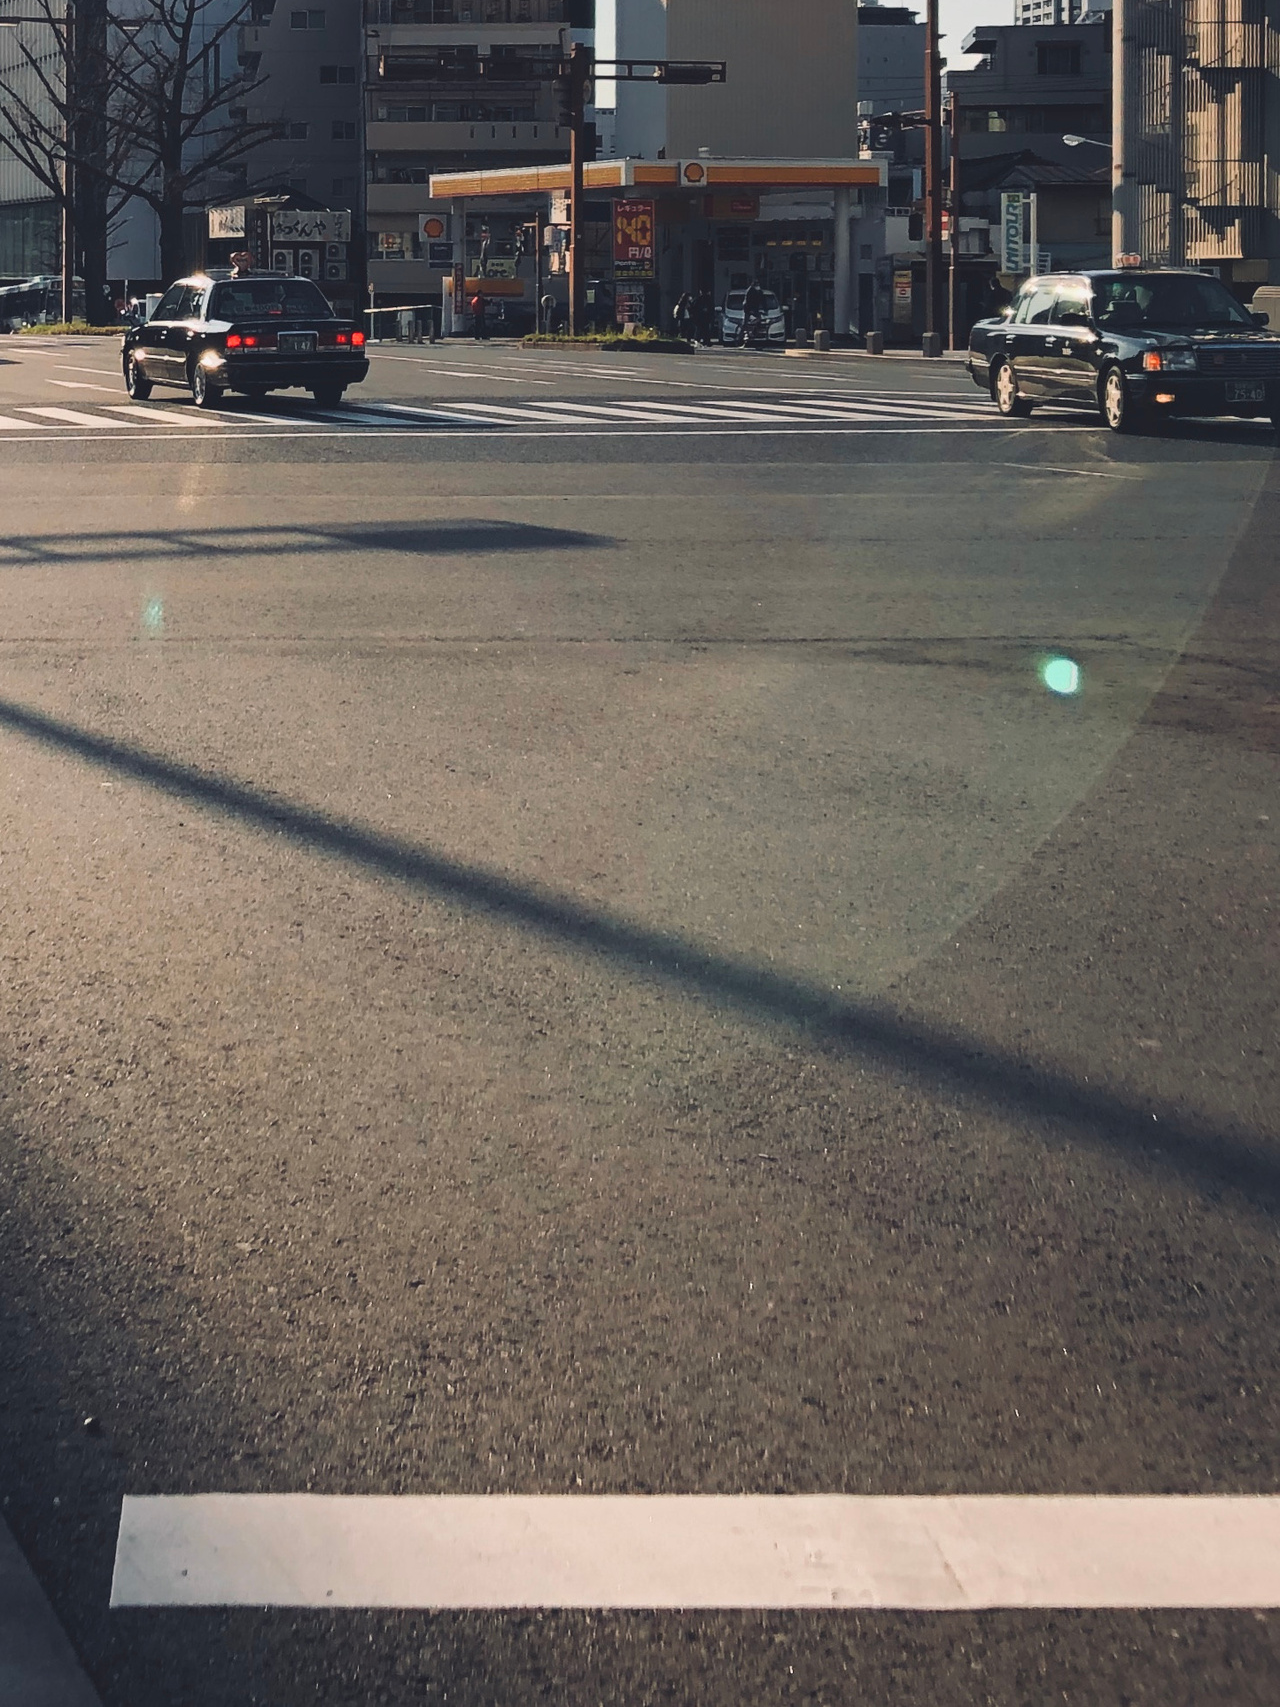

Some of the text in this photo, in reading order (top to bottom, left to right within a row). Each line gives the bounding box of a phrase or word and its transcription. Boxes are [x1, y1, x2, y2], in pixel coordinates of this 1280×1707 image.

[617, 204, 652, 212] レギュラー
